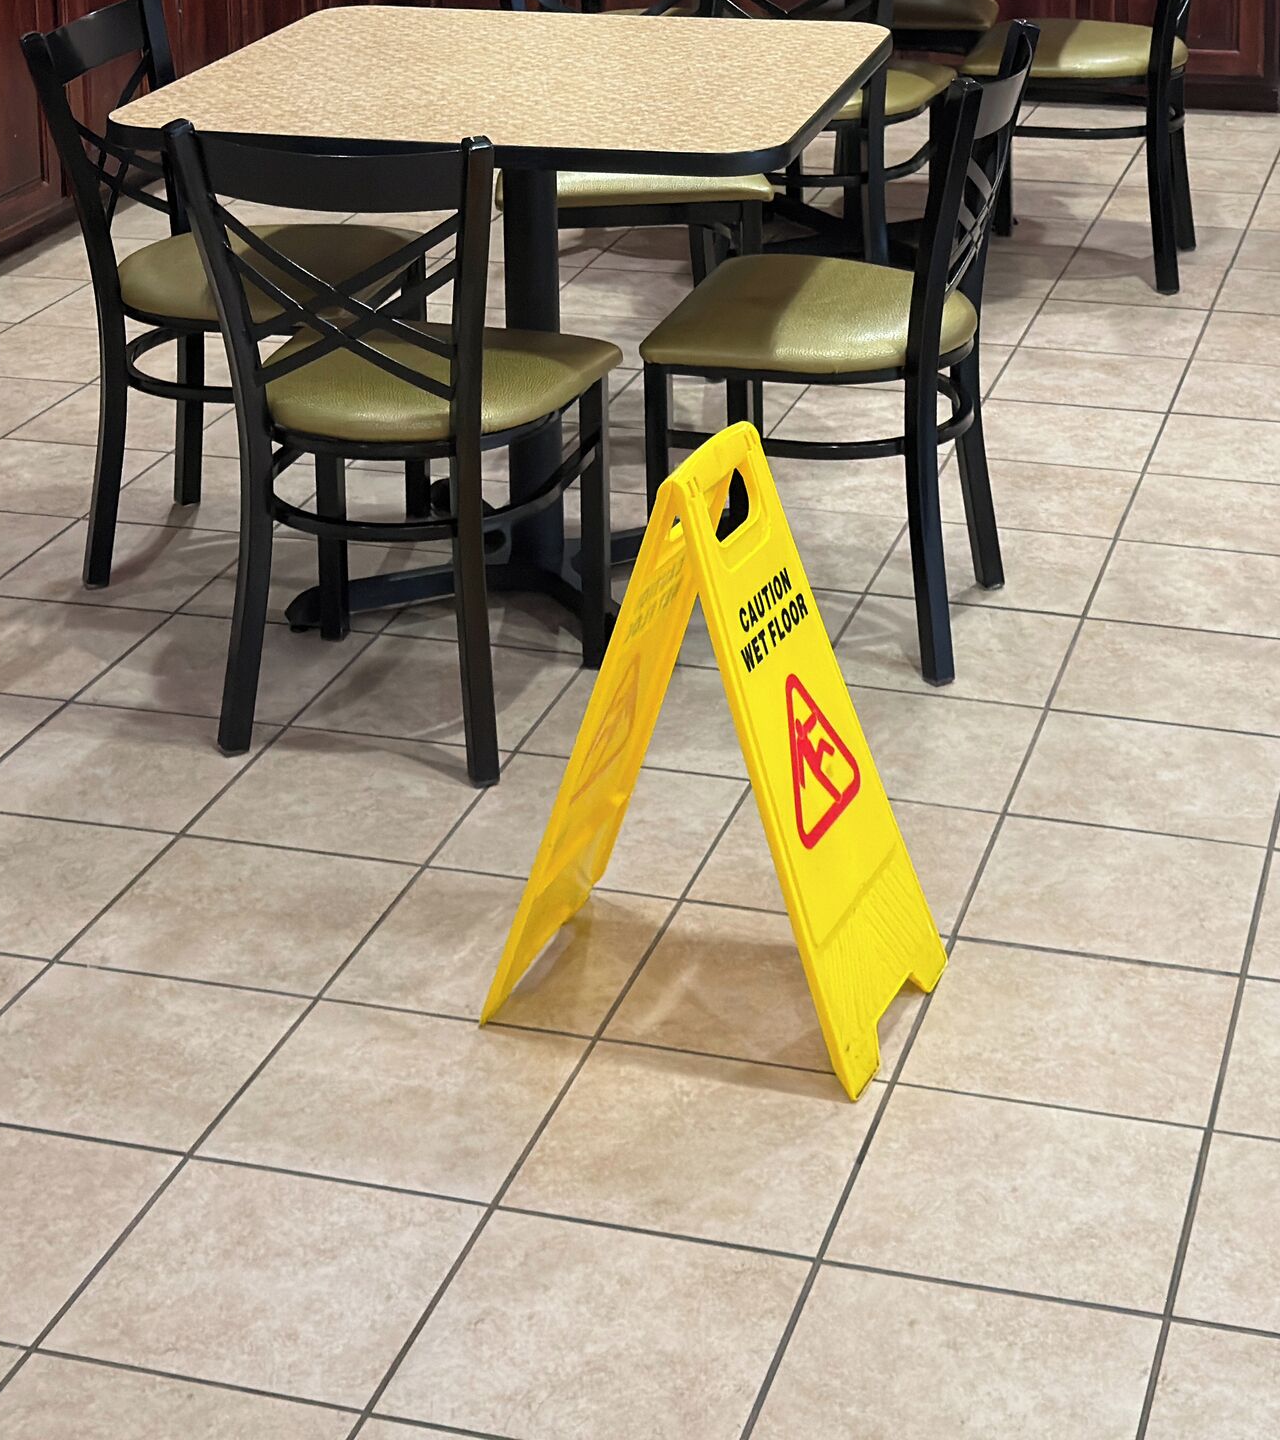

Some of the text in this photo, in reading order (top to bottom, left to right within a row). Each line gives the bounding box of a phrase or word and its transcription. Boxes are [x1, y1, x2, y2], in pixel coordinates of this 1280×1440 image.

[738, 567, 792, 632] CAUTION
[740, 593, 809, 673] WET FLOOR
